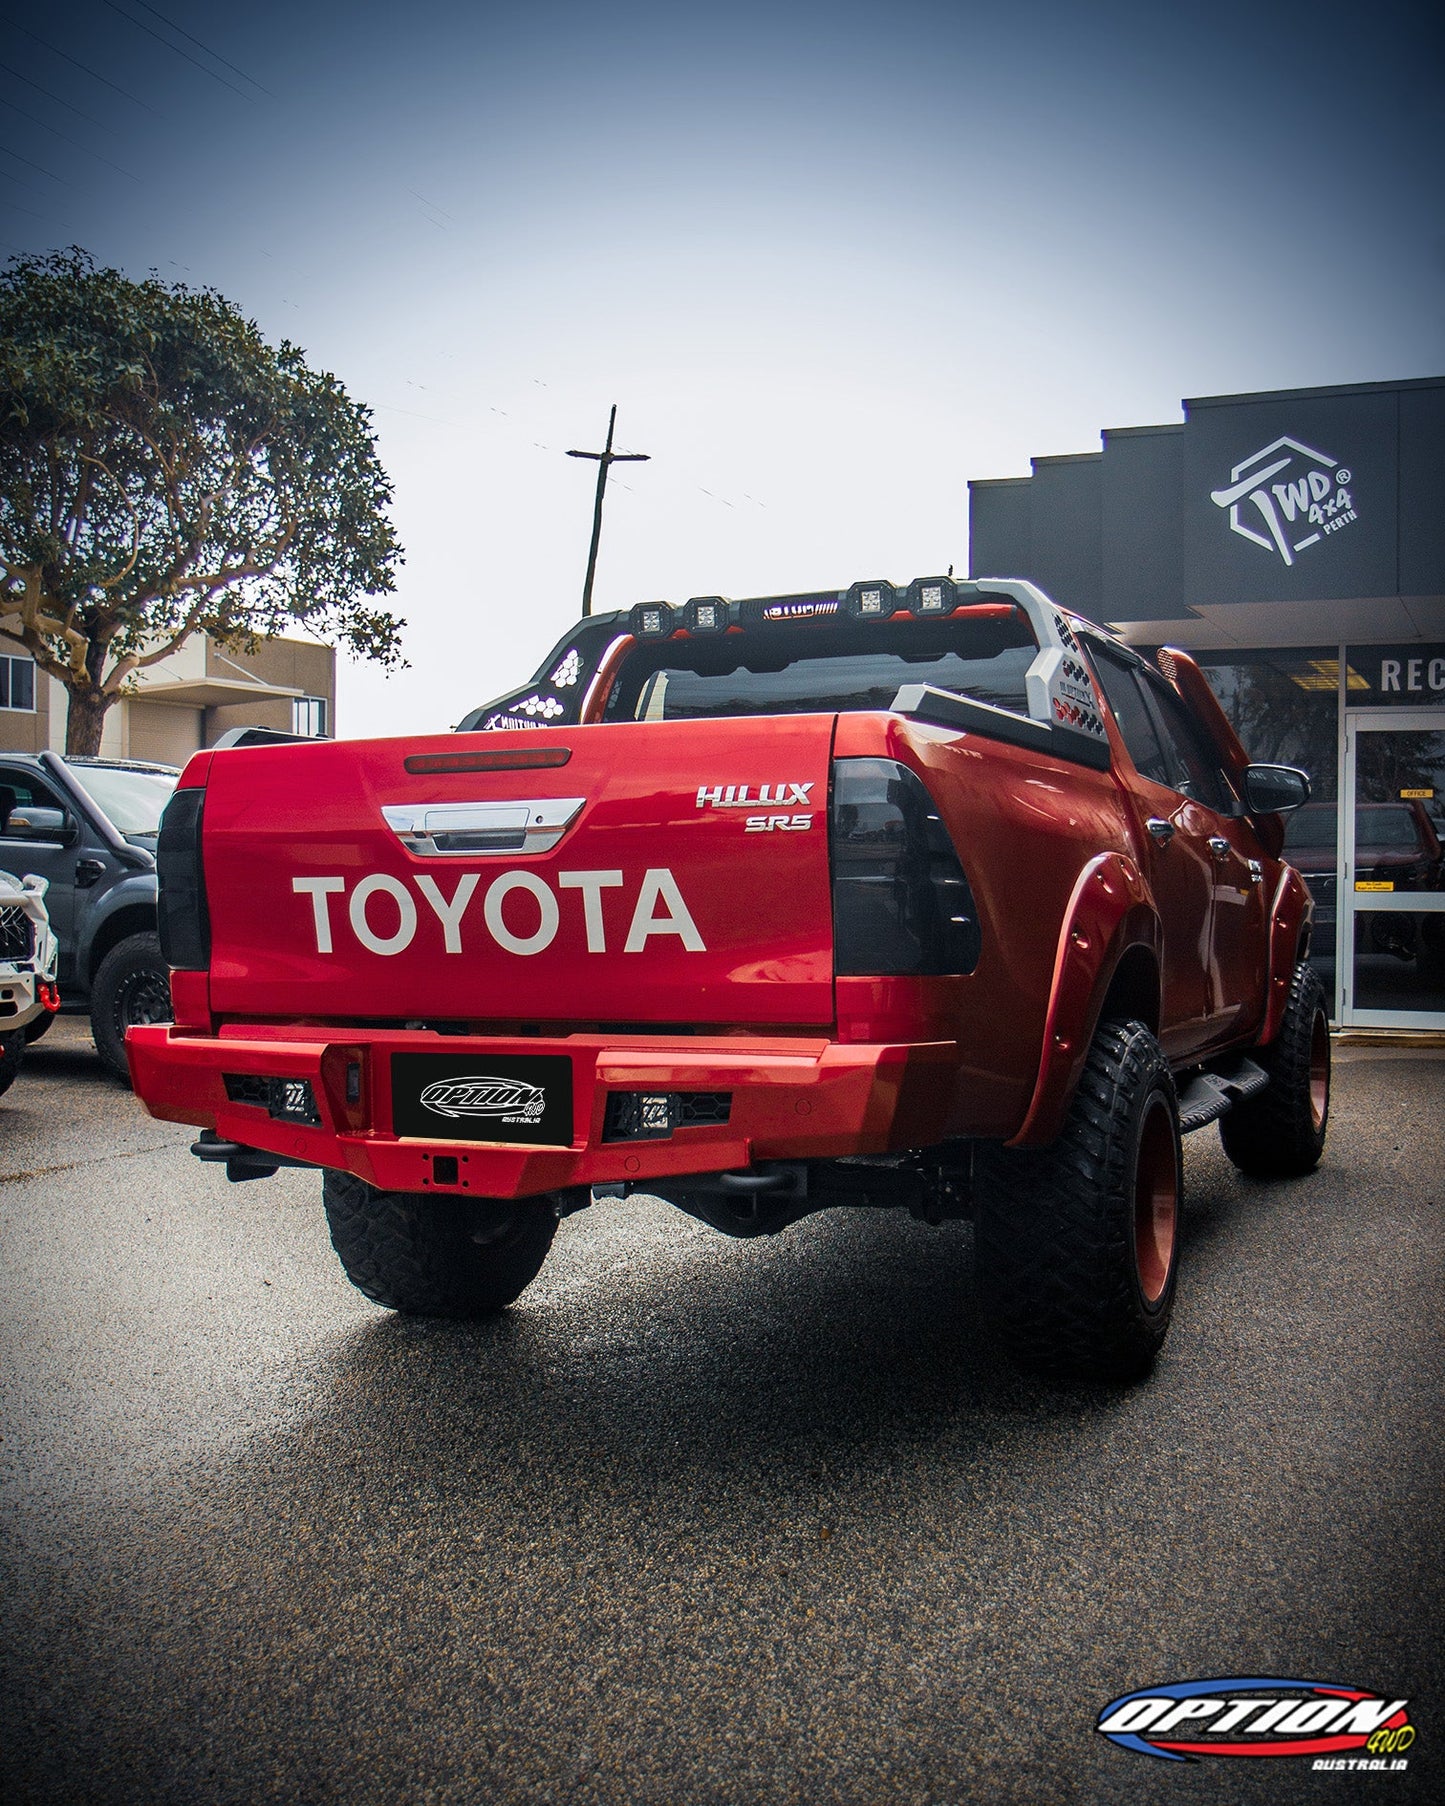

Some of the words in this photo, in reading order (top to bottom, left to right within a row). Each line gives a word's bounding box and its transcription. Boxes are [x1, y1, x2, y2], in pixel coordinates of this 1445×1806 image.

[1323, 509, 1357, 535] PERTH
[1381, 658, 1445, 691] REC
[696, 783, 814, 808] HILUX
[744, 814, 813, 832] SR5
[292, 868, 707, 956] TOYOTA
[420, 1085, 545, 1106] OPTION
